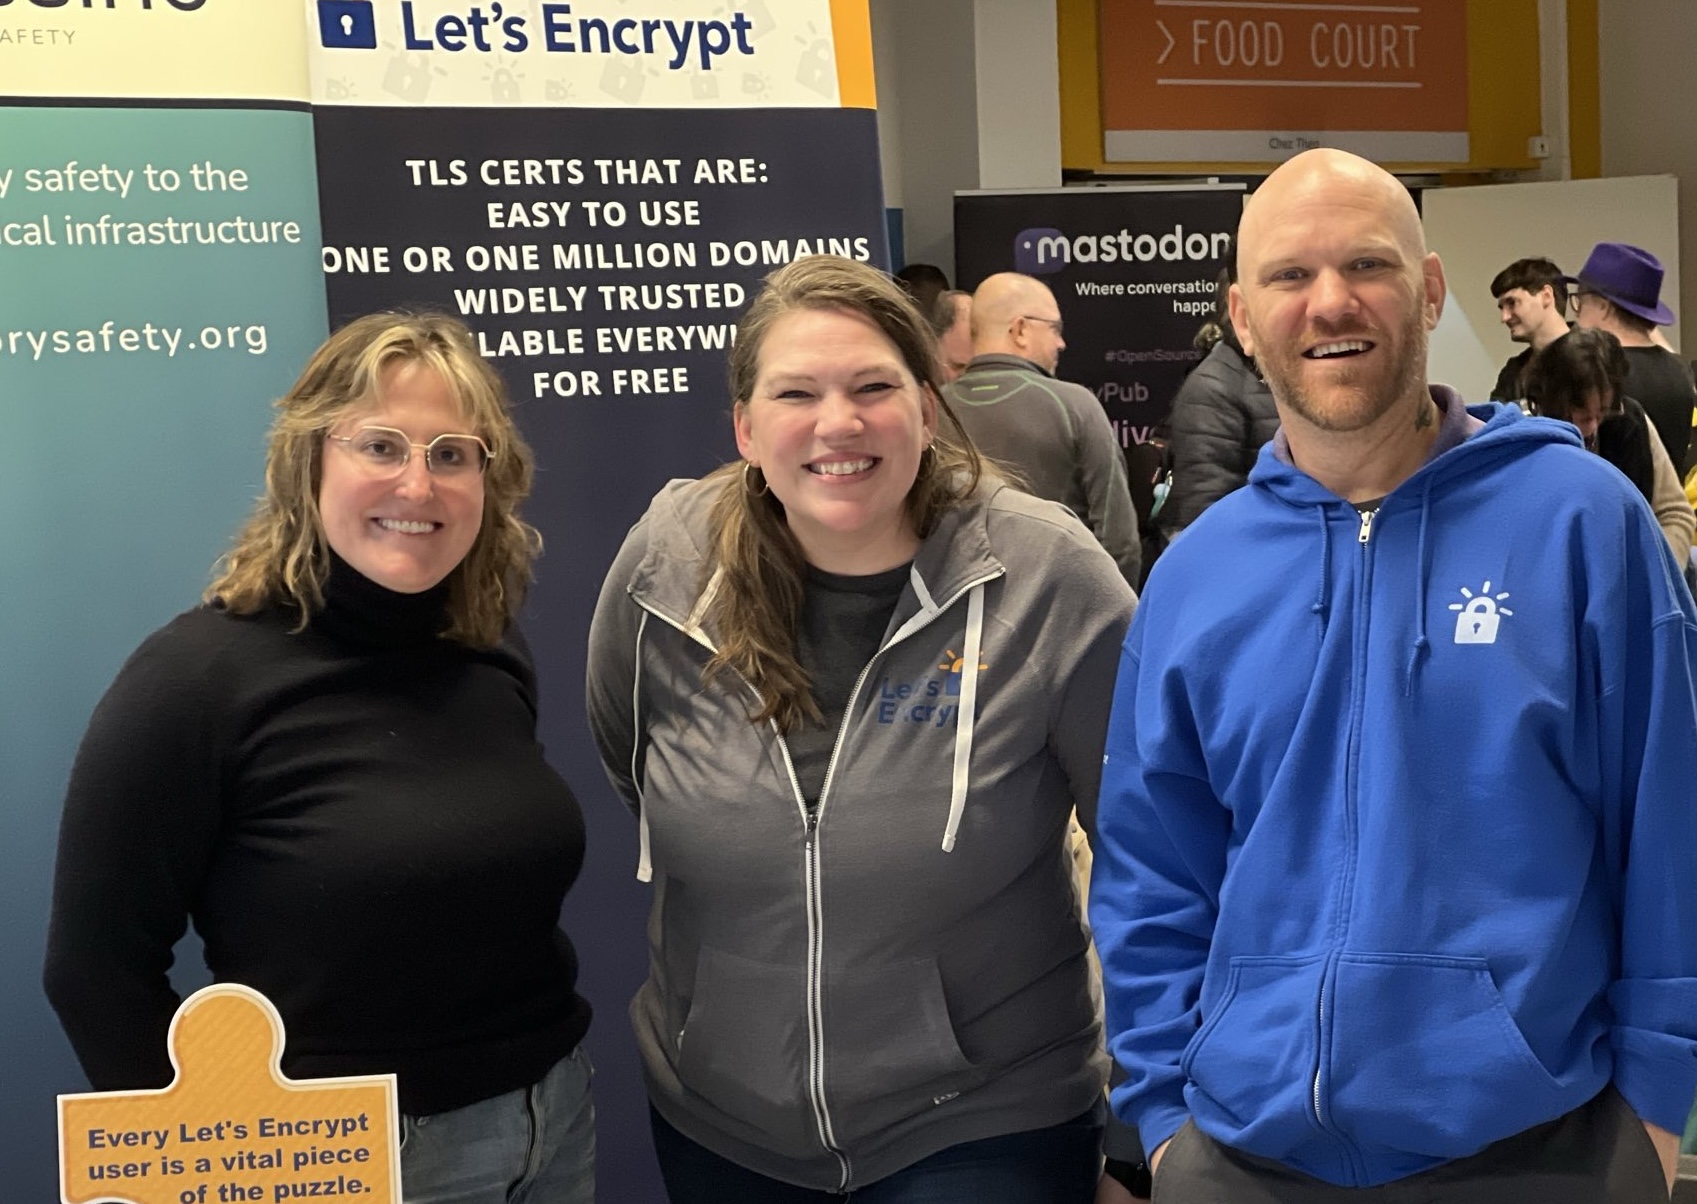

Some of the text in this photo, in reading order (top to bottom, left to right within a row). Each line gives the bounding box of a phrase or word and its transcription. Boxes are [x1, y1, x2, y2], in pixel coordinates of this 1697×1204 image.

[542, 3, 755, 70] Encrypt
[1192, 19, 1421, 69] FOOD COURT
[25, 161, 134, 198] safety
[144, 163, 181, 192] to
[190, 161, 249, 191] the
[406, 158, 769, 187] TLS CERTS THAT ARE:
[0, 214, 301, 246] cal infrastructure
[487, 200, 701, 229] EASY TO USE
[322, 237, 871, 273] ONE OR ONE MILLION DOMAINS
[1037, 224, 1231, 264] mastodon
[454, 283, 746, 315] WIDELY TRUSTED
[1075, 281, 1125, 296] Where
[0, 320, 270, 361] rysafety.org
[533, 367, 690, 398] FOR FREE
[88, 1112, 370, 1150] Every Let's Encrypt
[88, 1147, 370, 1180] user is a vital piece
[179, 1175, 371, 1204] of the puzzle.
